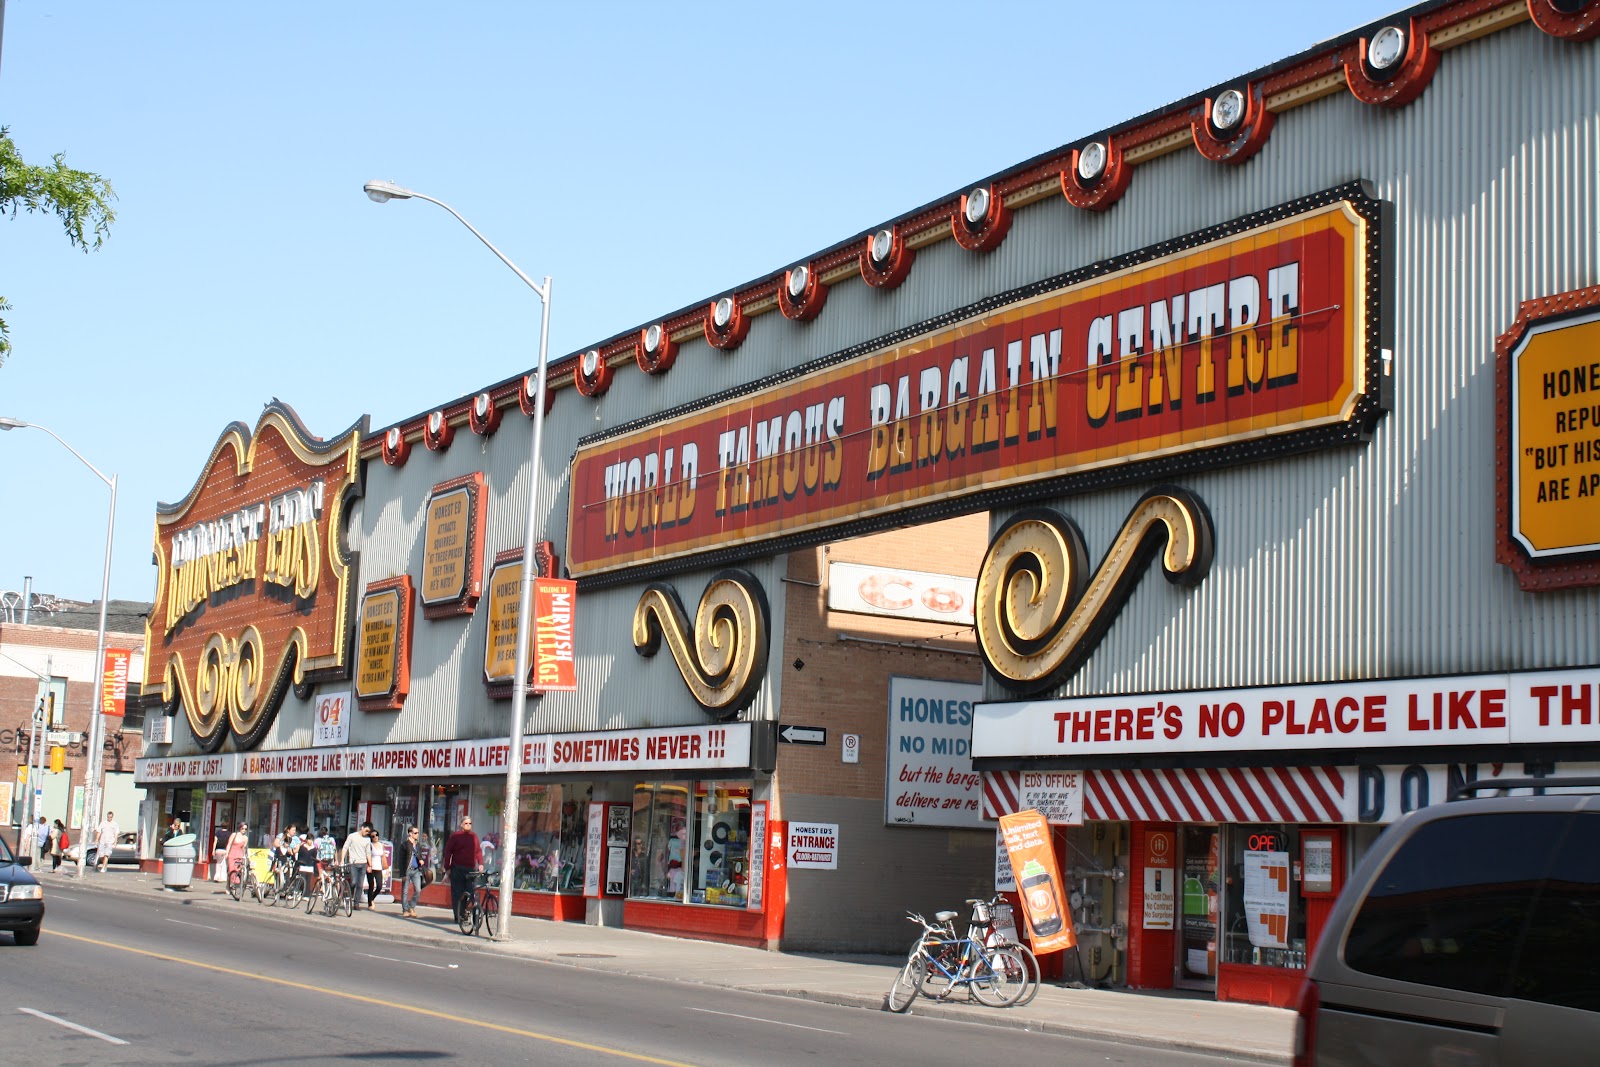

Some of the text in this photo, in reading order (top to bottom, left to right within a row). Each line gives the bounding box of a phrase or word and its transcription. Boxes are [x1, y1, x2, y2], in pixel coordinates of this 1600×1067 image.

[604, 260, 1300, 542] WORLD FAMOUS BARGAIN CENTRE
[1537, 477, 1570, 504] ARE
[434, 500, 462, 520] HONEST ED
[438, 520, 456, 535] ATTRACTS
[435, 550, 448, 563] THESE
[448, 547, 463, 560] PRICES
[432, 562, 456, 577] THEY THINK
[496, 581, 518, 598] HONEST
[540, 586, 560, 594] WELCOME
[858, 573, 975, 616] Co
[367, 603, 383, 618] HONEST
[503, 603, 506, 614] A
[371, 620, 384, 631] HONEST
[501, 618, 510, 630] HAS
[552, 593, 573, 661] MIRVISH
[367, 631, 389, 645] PEOPLE LOOK
[494, 633, 513, 647] COMING
[536, 615, 559, 684] VILLAGE
[113, 657, 127, 700] MIRVISH
[365, 672, 374, 683] THIS
[103, 671, 115, 713] VILLAGE
[1054, 702, 1183, 743] THERE'S
[1199, 702, 1245, 738] NO
[1261, 695, 1387, 735] PLACE
[1408, 689, 1506, 731] LIKE
[553, 737, 640, 764] SOMETIMES
[646, 734, 702, 760] NEVER
[899, 735, 925, 753] NO
[242, 759, 248, 774] A
[250, 756, 284, 774] BARGAIN
[286, 753, 319, 773] CENTRE
[322, 752, 341, 771] LIKE
[345, 752, 366, 770] THIS
[371, 750, 418, 769] HAPPENS
[421, 748, 451, 769] ONCE
[454, 747, 467, 768] IN
[469, 747, 476, 767] A
[165, 762, 171, 776] IN
[172, 762, 186, 776] AND
[188, 761, 200, 776] GET
[899, 764, 922, 782] but
[924, 766, 942, 784] the
[1024, 773, 1077, 788] ED'S OFFICE
[896, 791, 940, 809] delivers
[942, 798, 962, 809] are
[1057, 792, 1069, 800] HAVE
[795, 826, 818, 834] HONEST
[1003, 820, 1042, 835] Unlimited
[1022, 830, 1038, 840] text
[791, 835, 835, 849] ENTRANCE
[1010, 842, 1023, 852] and
[1162, 893, 1174, 901] Check
[1146, 902, 1173, 910] No Contract
